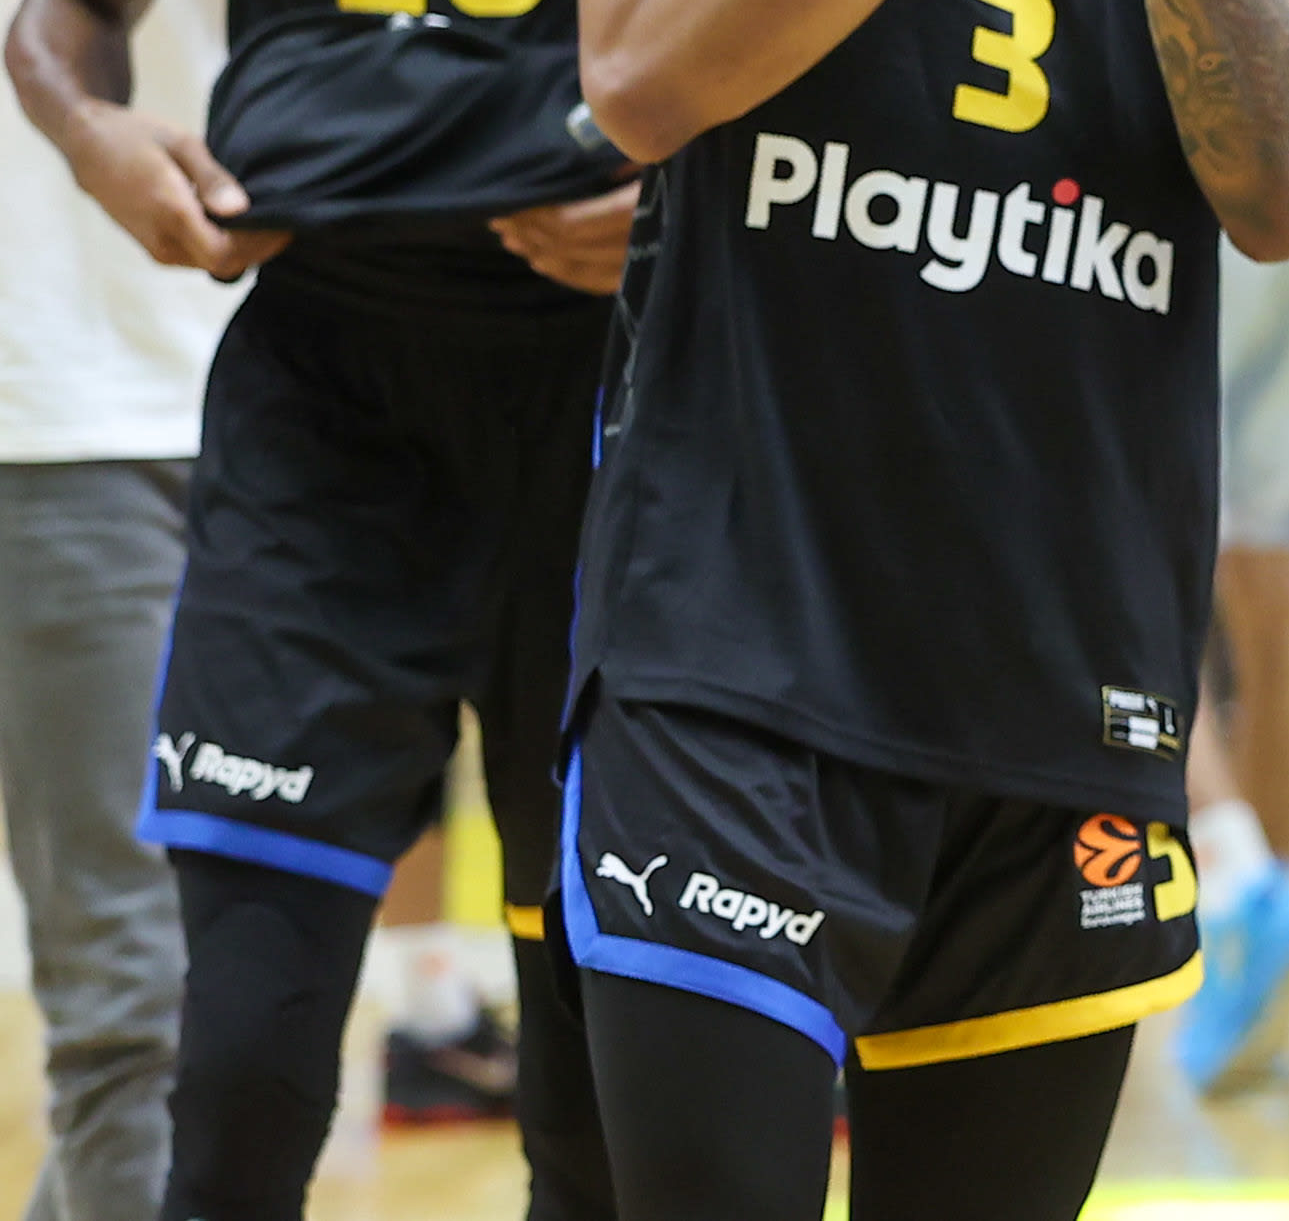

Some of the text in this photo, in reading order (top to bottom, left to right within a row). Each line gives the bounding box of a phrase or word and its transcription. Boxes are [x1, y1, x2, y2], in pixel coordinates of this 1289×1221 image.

[745, 132, 1174, 314] Playtika
[189, 741, 315, 803] Rapyd
[679, 871, 826, 946] Rapyd
